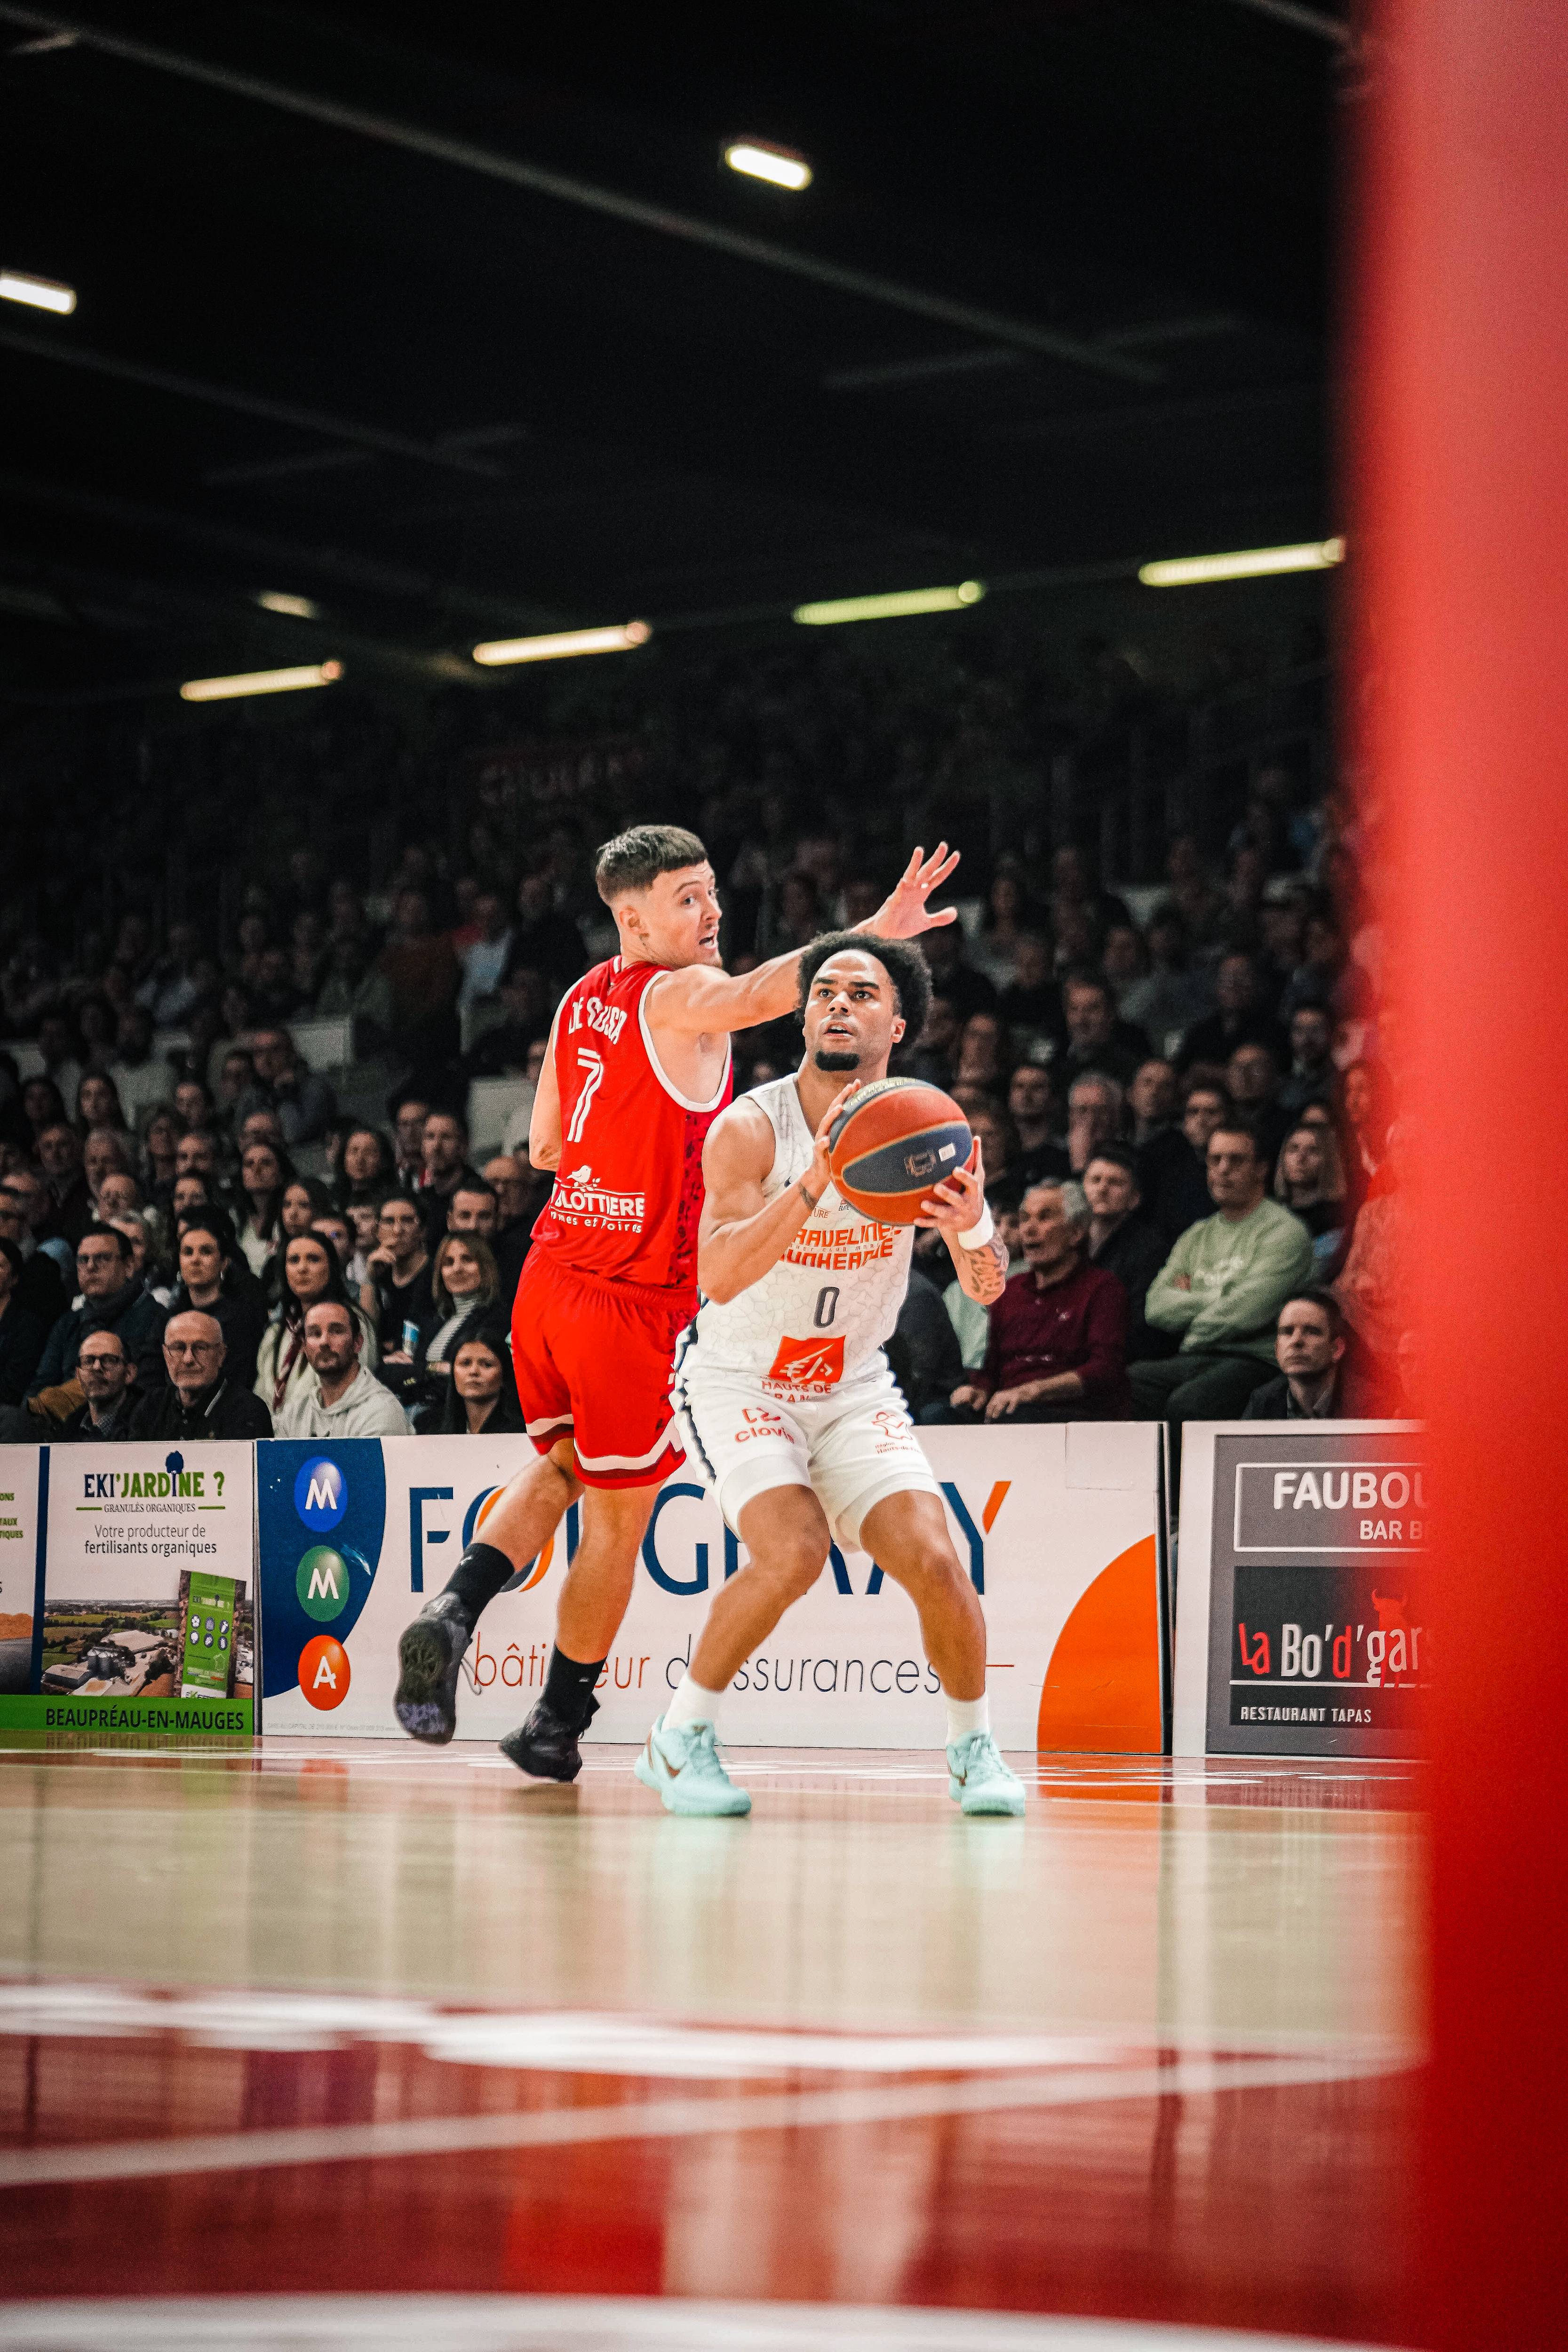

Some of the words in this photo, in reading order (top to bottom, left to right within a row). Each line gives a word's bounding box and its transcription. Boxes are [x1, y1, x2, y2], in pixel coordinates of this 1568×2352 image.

[567, 1047, 603, 1143] 7
[794, 1222, 902, 1247] RAVELINE
[813, 1287, 840, 1328] 0
[762, 1381, 809, 1393] HAUTS
[813, 1383, 832, 1394] DE
[84, 1470, 205, 1498] EKI'JARDINE
[304, 1478, 337, 1510] M
[103, 1502, 144, 1513] GRANULÉS
[146, 1503, 196, 1514] ORGANIQUES
[95, 1525, 124, 1538] Votre
[127, 1523, 189, 1542] producteur
[192, 1524, 206, 1538] de
[1360, 1520, 1402, 1540] BAR
[85, 1540, 148, 1553] fertilisants
[151, 1540, 217, 1557] organiques
[307, 1567, 340, 1600] M
[1238, 1623, 1270, 1675] La
[312, 1655, 337, 1690] A
[46, 1704, 244, 1731] BEAUPRÉAU-EN-MAUGES
[1241, 1706, 1326, 1722] RESTAURANT
[1331, 1708, 1371, 1723] TAPAS
